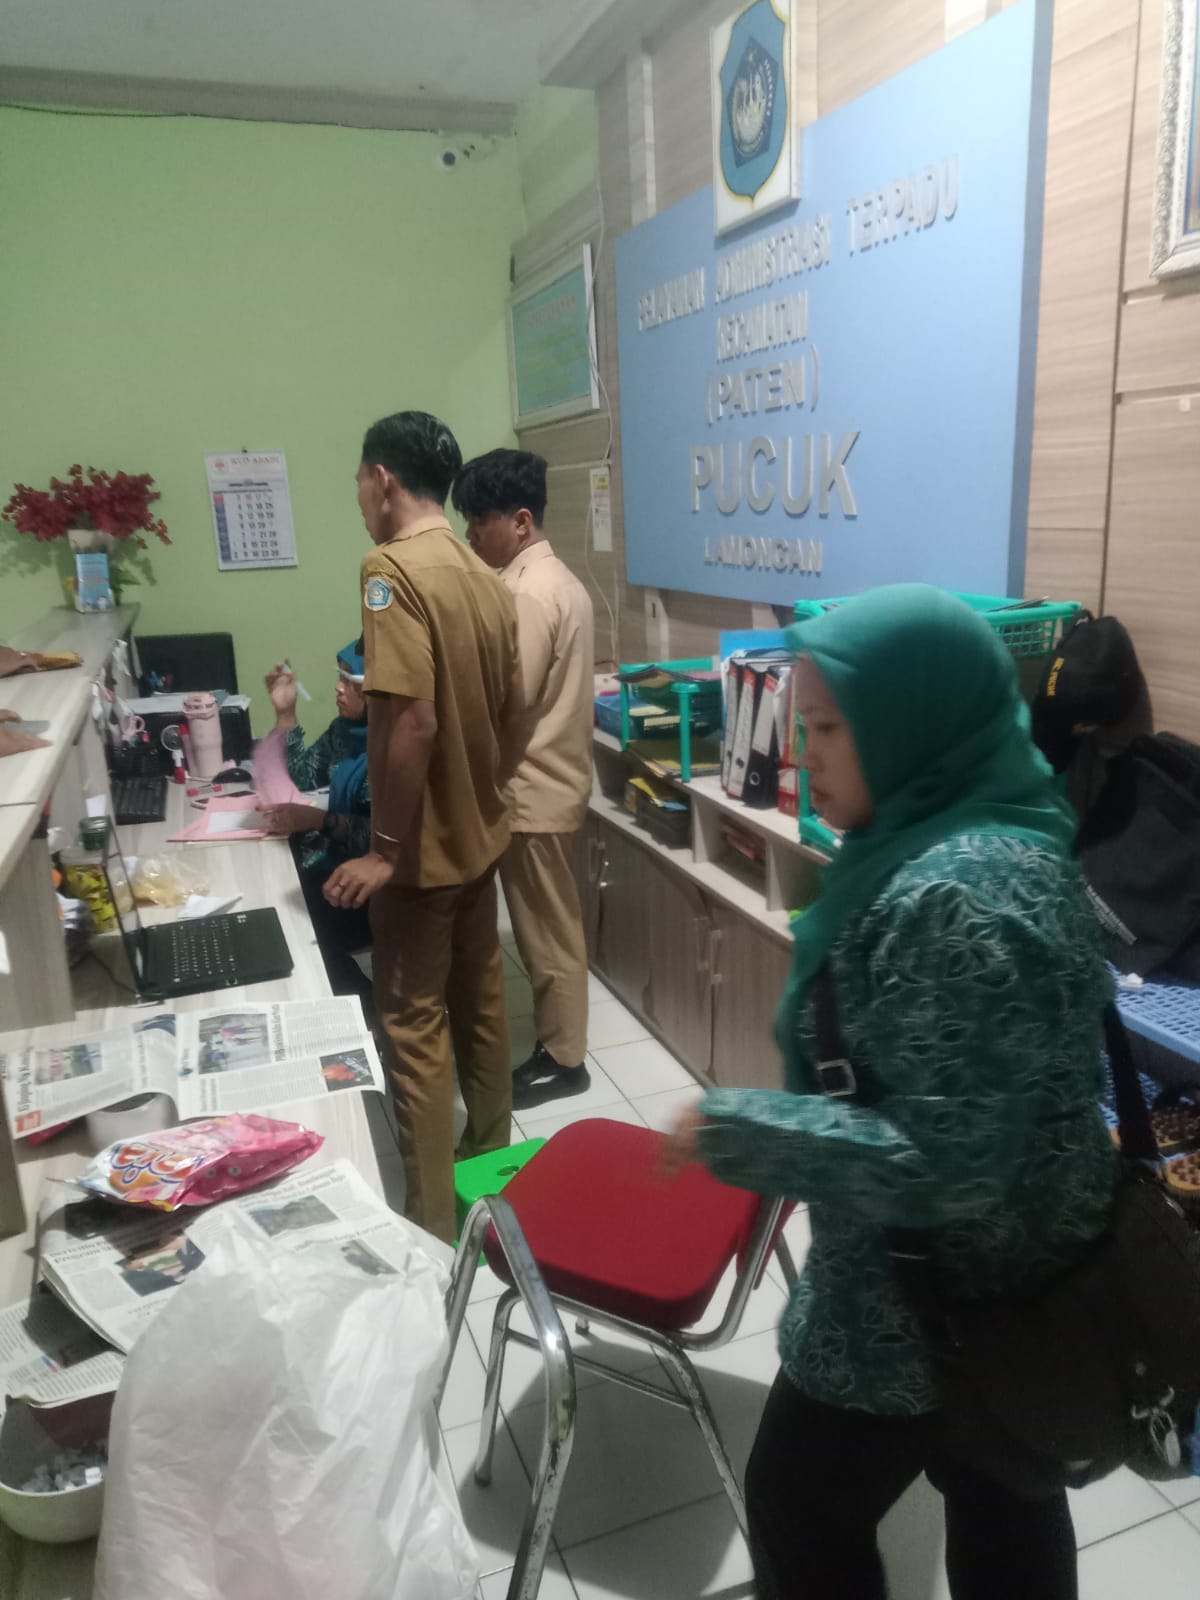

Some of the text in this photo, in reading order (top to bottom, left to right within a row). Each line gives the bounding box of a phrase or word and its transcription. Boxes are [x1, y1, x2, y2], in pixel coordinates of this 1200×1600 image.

[846, 155, 959, 256] TERPADU
[706, 344, 821, 427] (PATEN)
[690, 431, 861, 520] PUCUK
[704, 535, 824, 577] LAMONGAN
